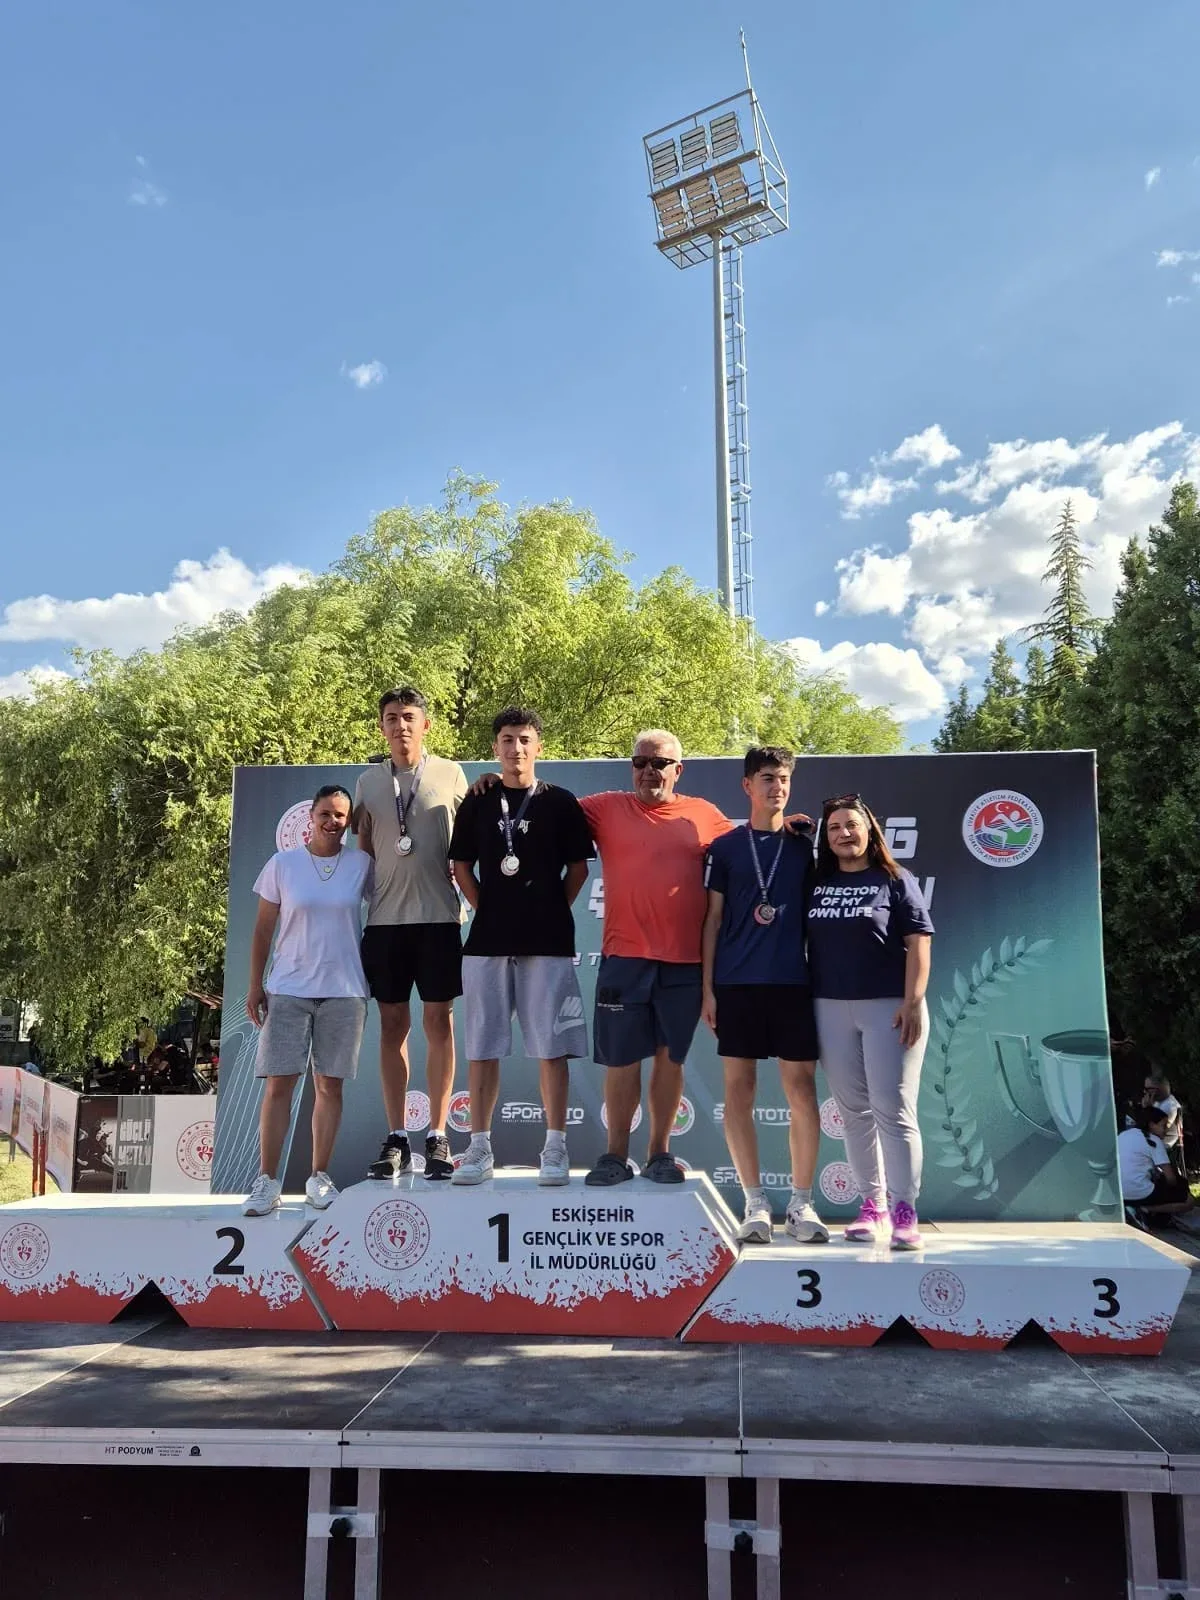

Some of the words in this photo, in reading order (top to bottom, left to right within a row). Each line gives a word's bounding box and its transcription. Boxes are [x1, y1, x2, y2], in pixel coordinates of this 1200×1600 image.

[813, 885, 880, 896] DIRECTOR
[820, 897, 839, 906] OF
[841, 896, 863, 906] MY
[808, 907, 841, 918] OWN
[844, 906, 873, 918] LIFE
[501, 1106, 584, 1119] SPORTO
[552, 1205, 634, 1226] ESKİŞEHİR
[488, 1213, 509, 1262] 1
[522, 1229, 592, 1249] GENÇLİK
[595, 1231, 616, 1246] VE
[620, 1232, 664, 1247] SPOR
[213, 1226, 245, 1274] 2
[530, 1252, 544, 1269] İL
[549, 1252, 656, 1270] MÜDÜRLÜĞÜ
[796, 1269, 822, 1308] 3
[1092, 1278, 1120, 1318] 3
[105, 1446, 116, 1454] HT
[118, 1446, 154, 1455] PODYUM
